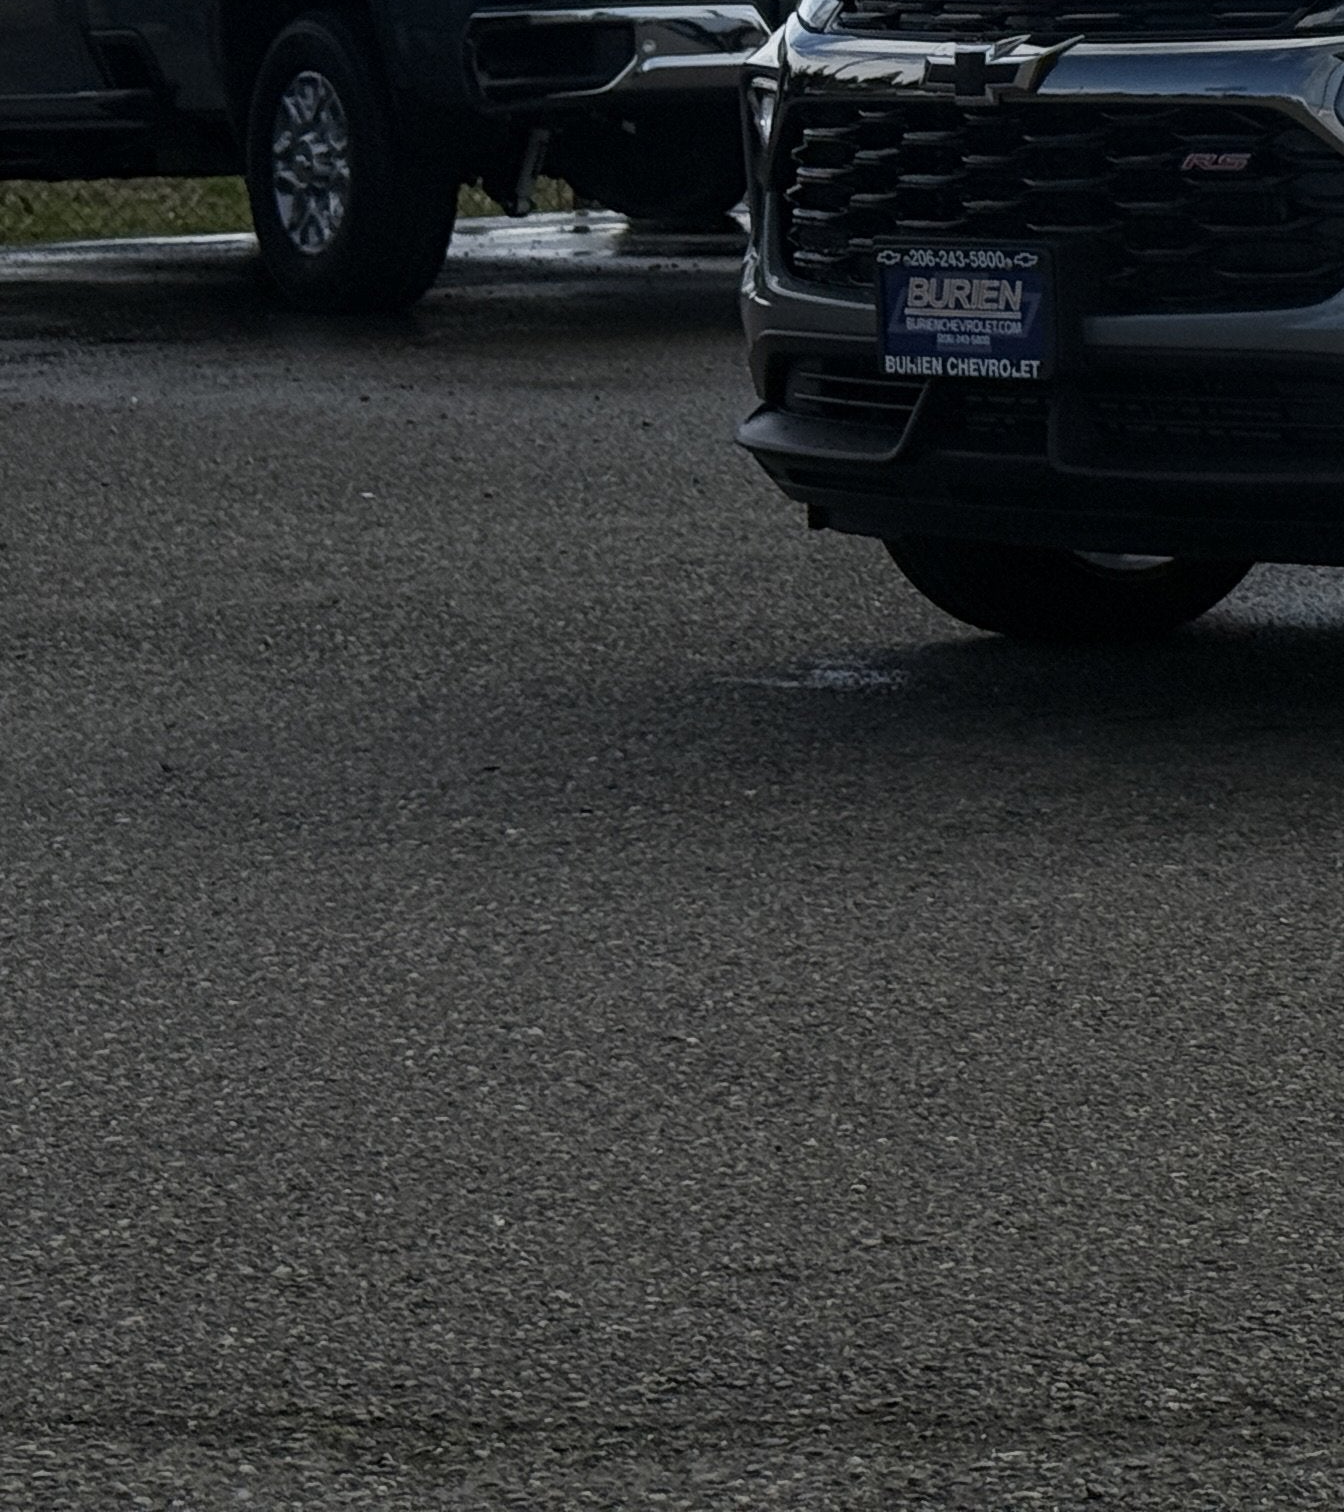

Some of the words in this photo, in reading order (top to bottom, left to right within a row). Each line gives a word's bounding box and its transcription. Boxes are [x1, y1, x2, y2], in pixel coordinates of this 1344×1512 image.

[1181, 153, 1252, 171] RS
[909, 249, 1005, 268] 206-243-5800
[907, 276, 1023, 311] BURIEN
